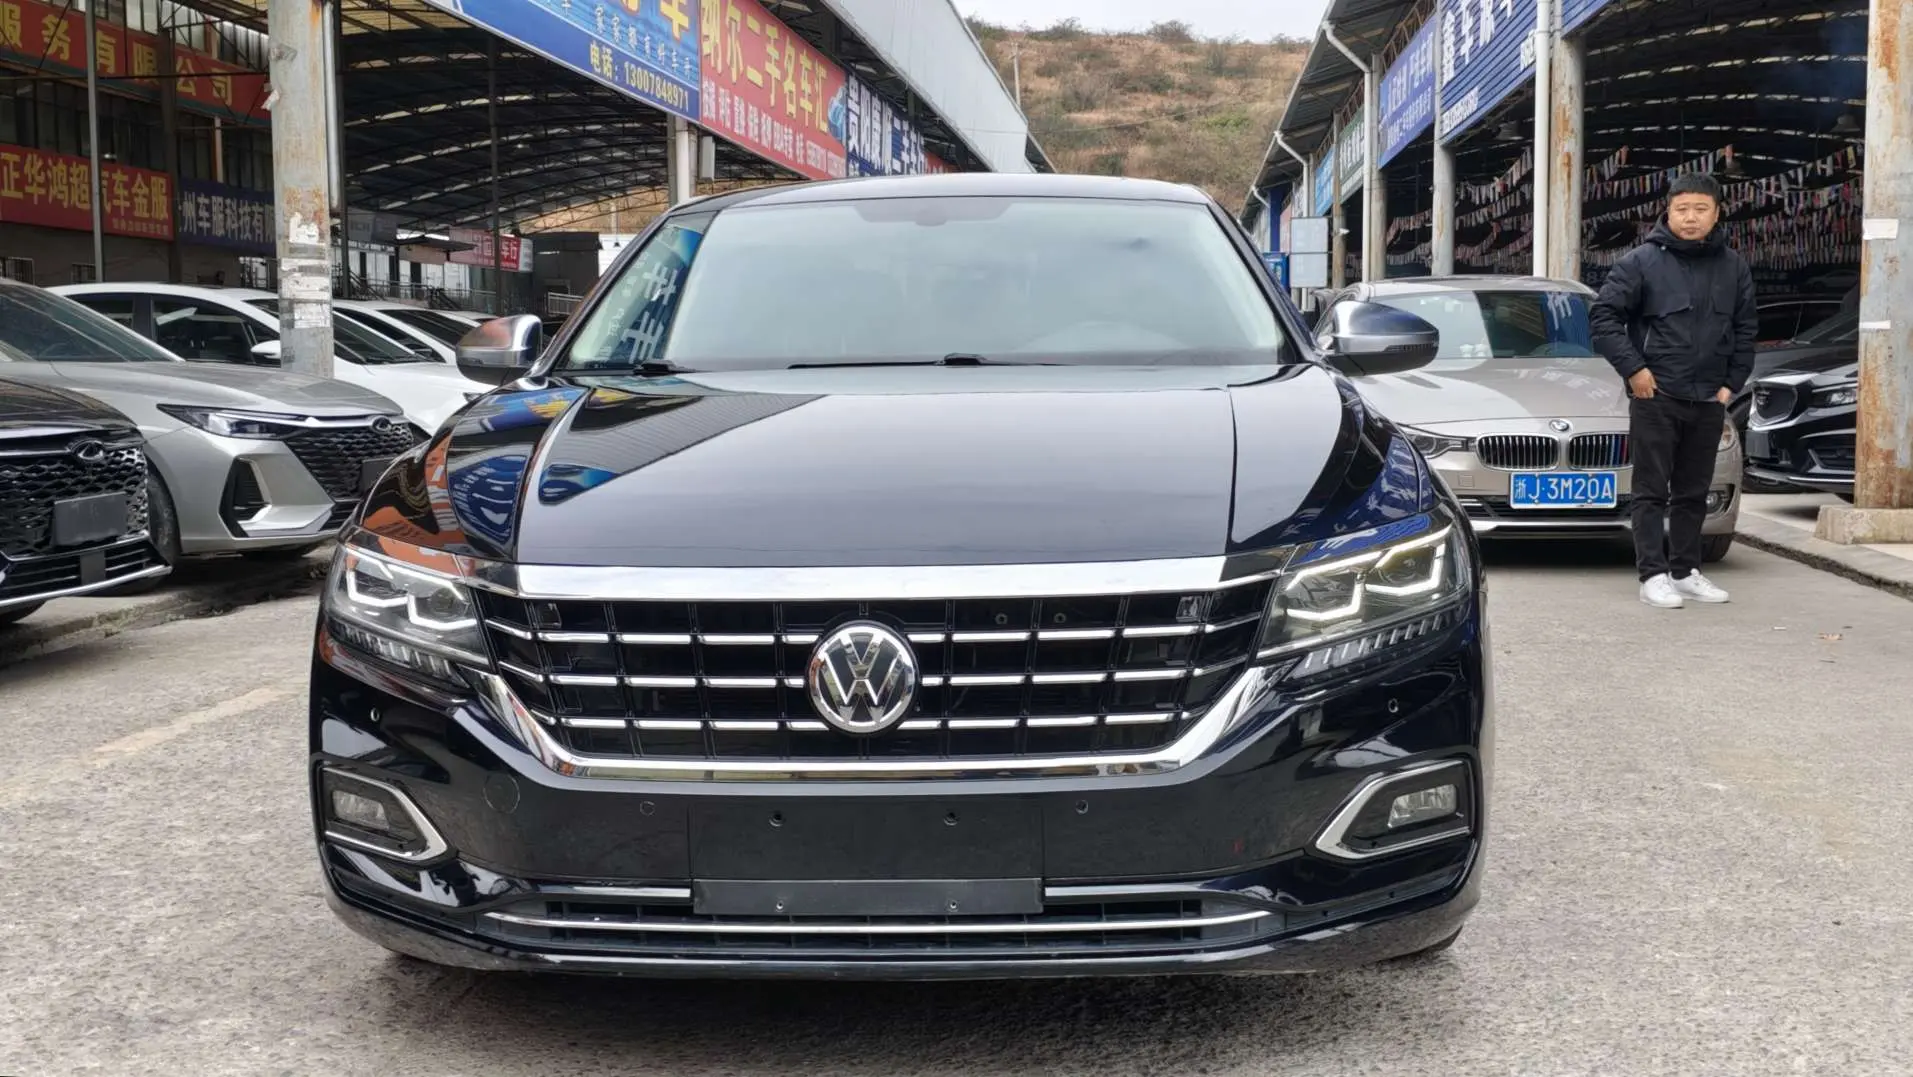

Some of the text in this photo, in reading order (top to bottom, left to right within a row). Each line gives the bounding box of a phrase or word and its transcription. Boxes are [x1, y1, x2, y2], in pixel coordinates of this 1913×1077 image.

[0, 3, 233, 106] 服务有限公司
[178, 190, 276, 243] 州车服科技有限
